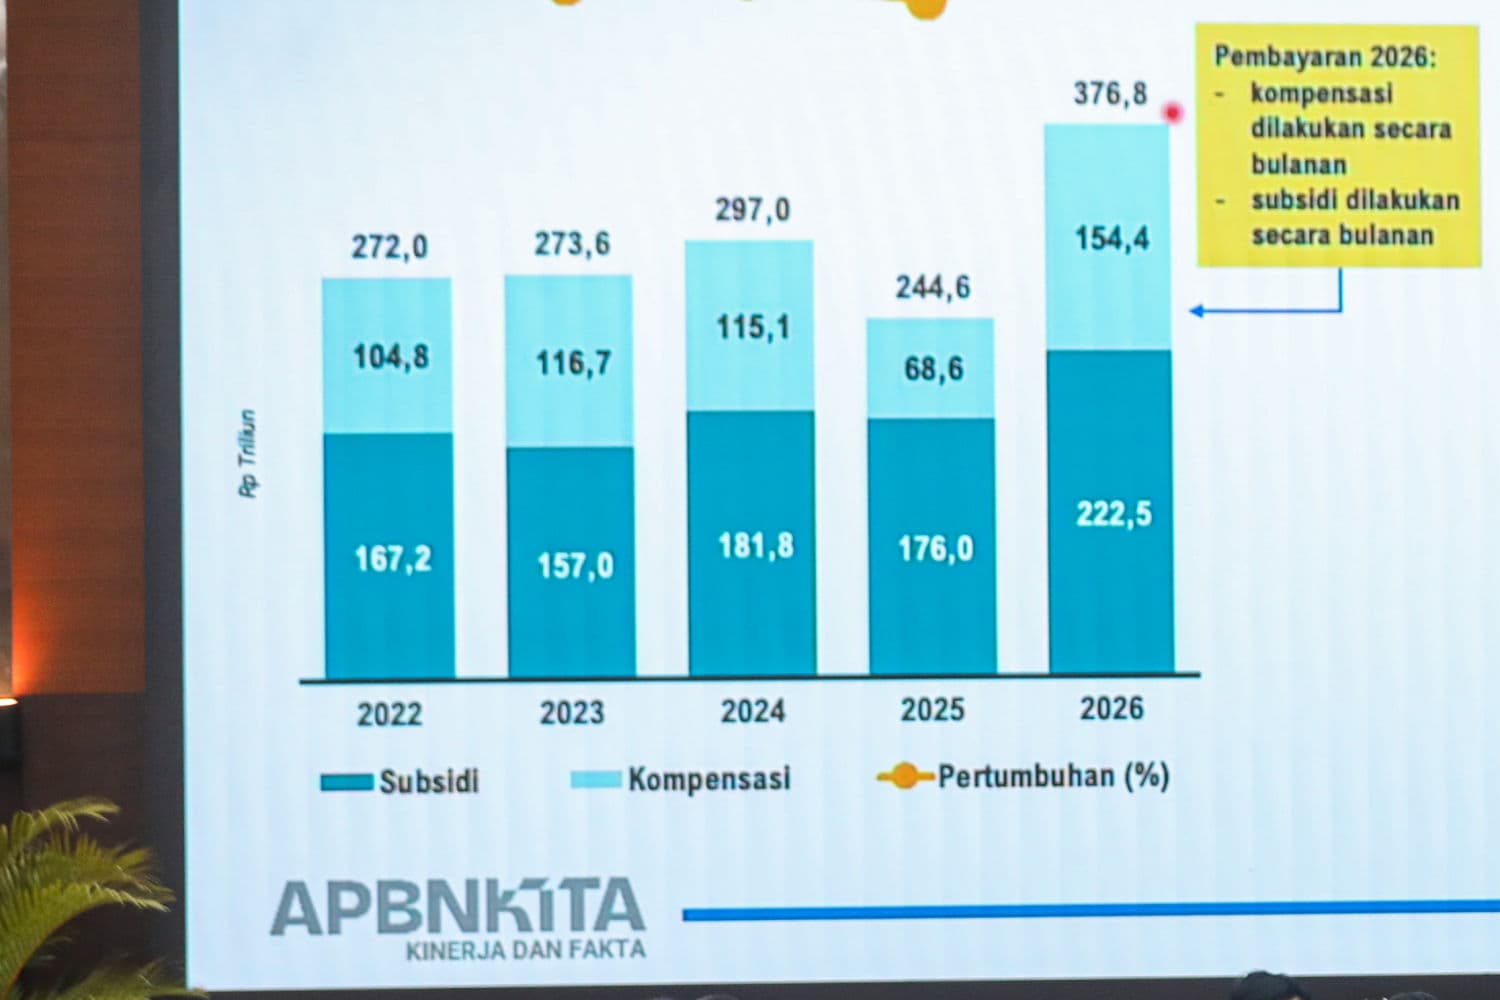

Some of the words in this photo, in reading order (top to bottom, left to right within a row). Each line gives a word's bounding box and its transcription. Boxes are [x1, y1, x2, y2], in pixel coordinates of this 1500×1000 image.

[1216, 44, 1362, 73] Pembayaran
[1371, 45, 1435, 67] 2026:
[1075, 81, 1147, 109] 376,8
[1252, 82, 1392, 109] kompensasi
[1252, 116, 1364, 138] dilakukan
[1374, 123, 1452, 139] secara
[1252, 153, 1346, 175] bulanan
[716, 197, 790, 225] 297,0
[1252, 188, 1337, 210] subsidi
[1347, 188, 1459, 210] dilakukan
[535, 231, 610, 260] 273,6
[1076, 225, 1149, 254] 154,4
[1253, 228, 1330, 245] secara
[1340, 223, 1434, 245] bulanan
[352, 234, 427, 263] 272,0
[896, 274, 970, 303] 244,6
[718, 314, 788, 343] 115,1
[354, 344, 428, 372] 104,8
[537, 350, 611, 379] 116,7
[905, 356, 963, 385] 68,6
[238, 410, 256, 466] Triliun
[238, 474, 259, 498] Rp
[1076, 500, 1151, 530] 222,5
[355, 545, 431, 576] 167,2
[719, 531, 793, 562] 181,8
[899, 535, 973, 565] 176,0
[538, 552, 613, 582] 157,0
[357, 702, 422, 726] 2022
[540, 700, 604, 725] 2023
[721, 698, 785, 723] 2024
[901, 697, 964, 721] 2025
[1081, 696, 1144, 720] 2026
[380, 768, 478, 794] Subsidi
[630, 765, 790, 797] Kompensasi
[940, 763, 1114, 788] Pertumbuhan
[1125, 761, 1169, 793] (%)
[406, 941, 506, 961] KINERJA
[513, 940, 562, 960] DAN
[569, 939, 646, 959] FAKTA
